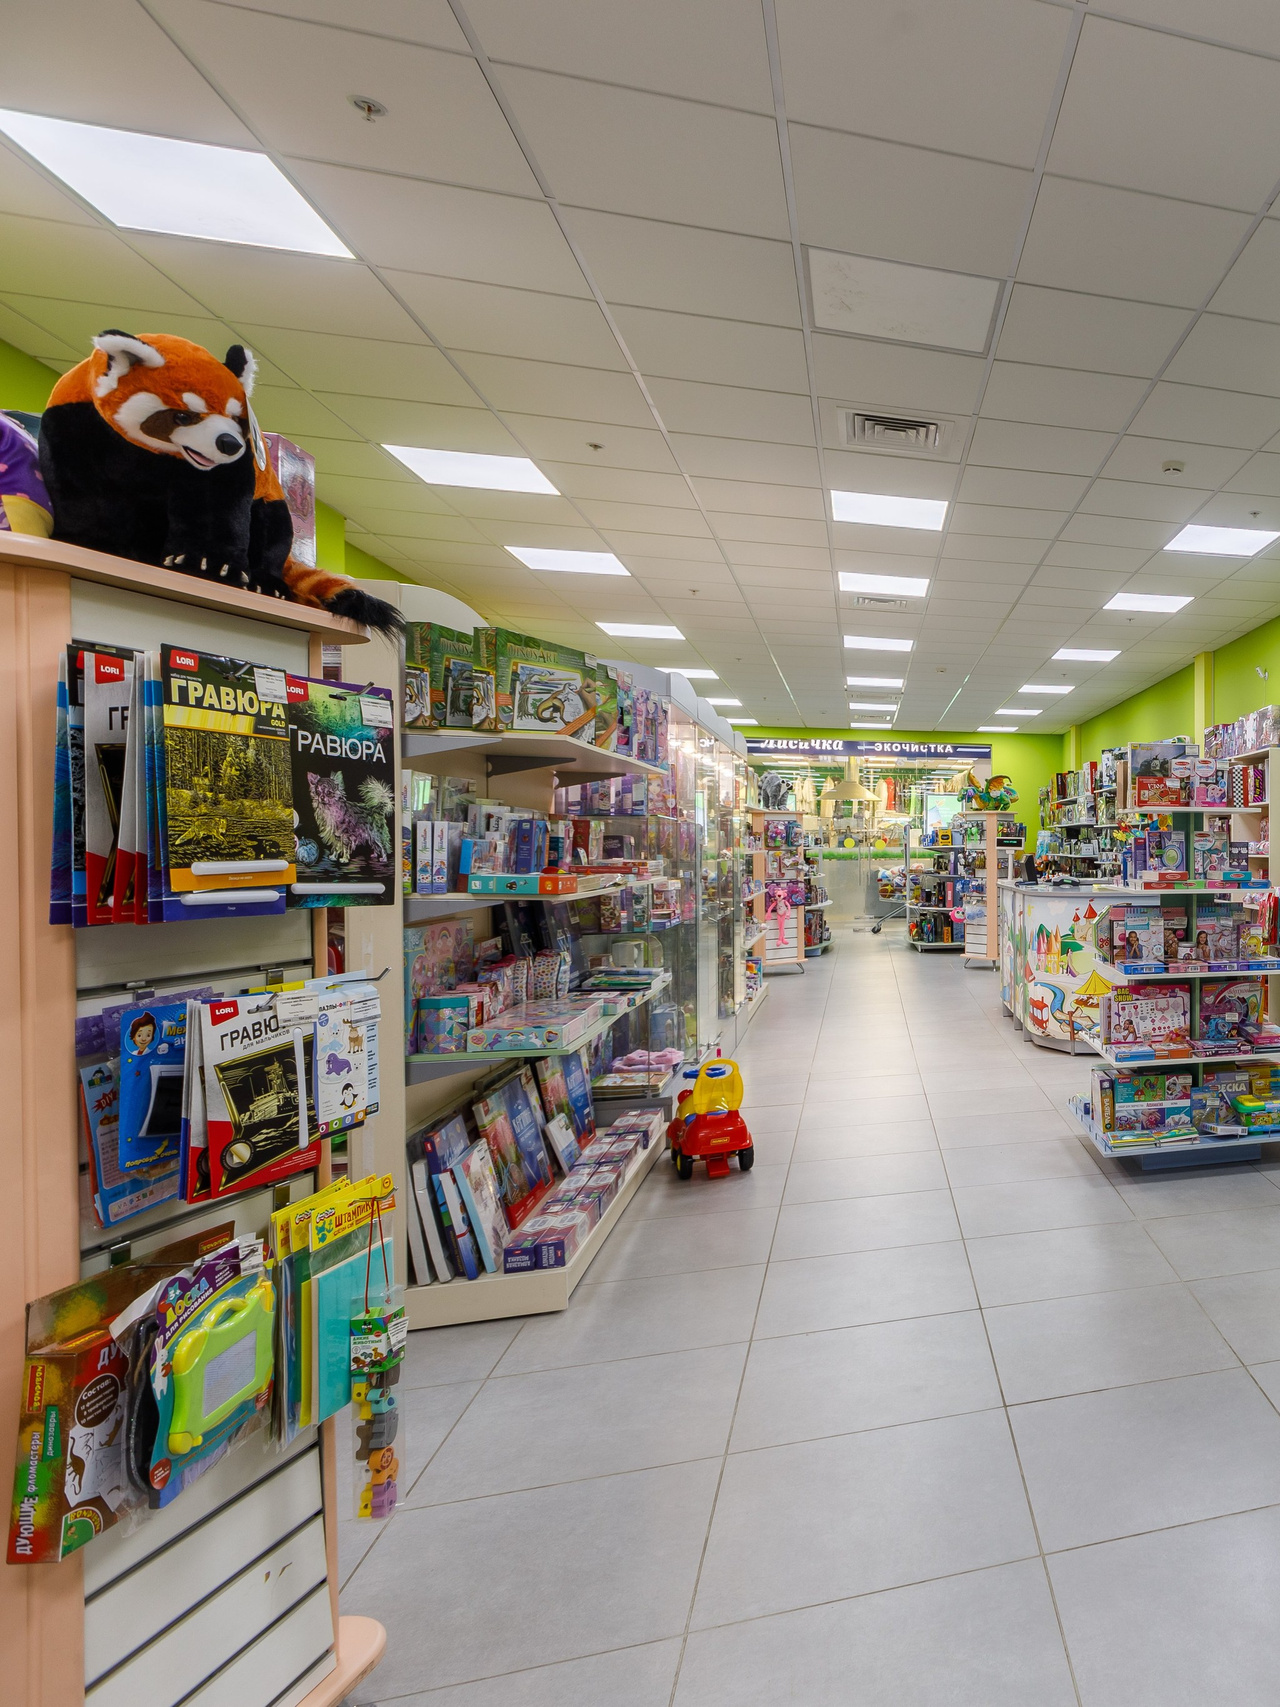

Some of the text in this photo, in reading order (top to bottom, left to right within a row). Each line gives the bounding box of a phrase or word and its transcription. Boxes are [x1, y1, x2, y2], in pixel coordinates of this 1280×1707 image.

[176, 655, 195, 666] LORI
[100, 665, 120, 675] LORI
[170, 677, 286, 719] ГРАВЮРА
[286, 686, 304, 695] LORI
[271, 719, 285, 728] GOLD
[288, 724, 386, 764] ГРАВЮРА
[1114, 994, 1133, 1002] SHOW
[215, 1006, 234, 1016] LORI
[220, 1014, 286, 1051] ГРАВЮ
[242, 1029, 291, 1050] для мальчиков
[166, 1277, 210, 1328] ДОСКА
[169, 1289, 181, 1300] 3+
[165, 1287, 214, 1340] ДЛЯ РИСОВАНИЯ
[16, 1495, 39, 1555] ДУЮЩИЕ
